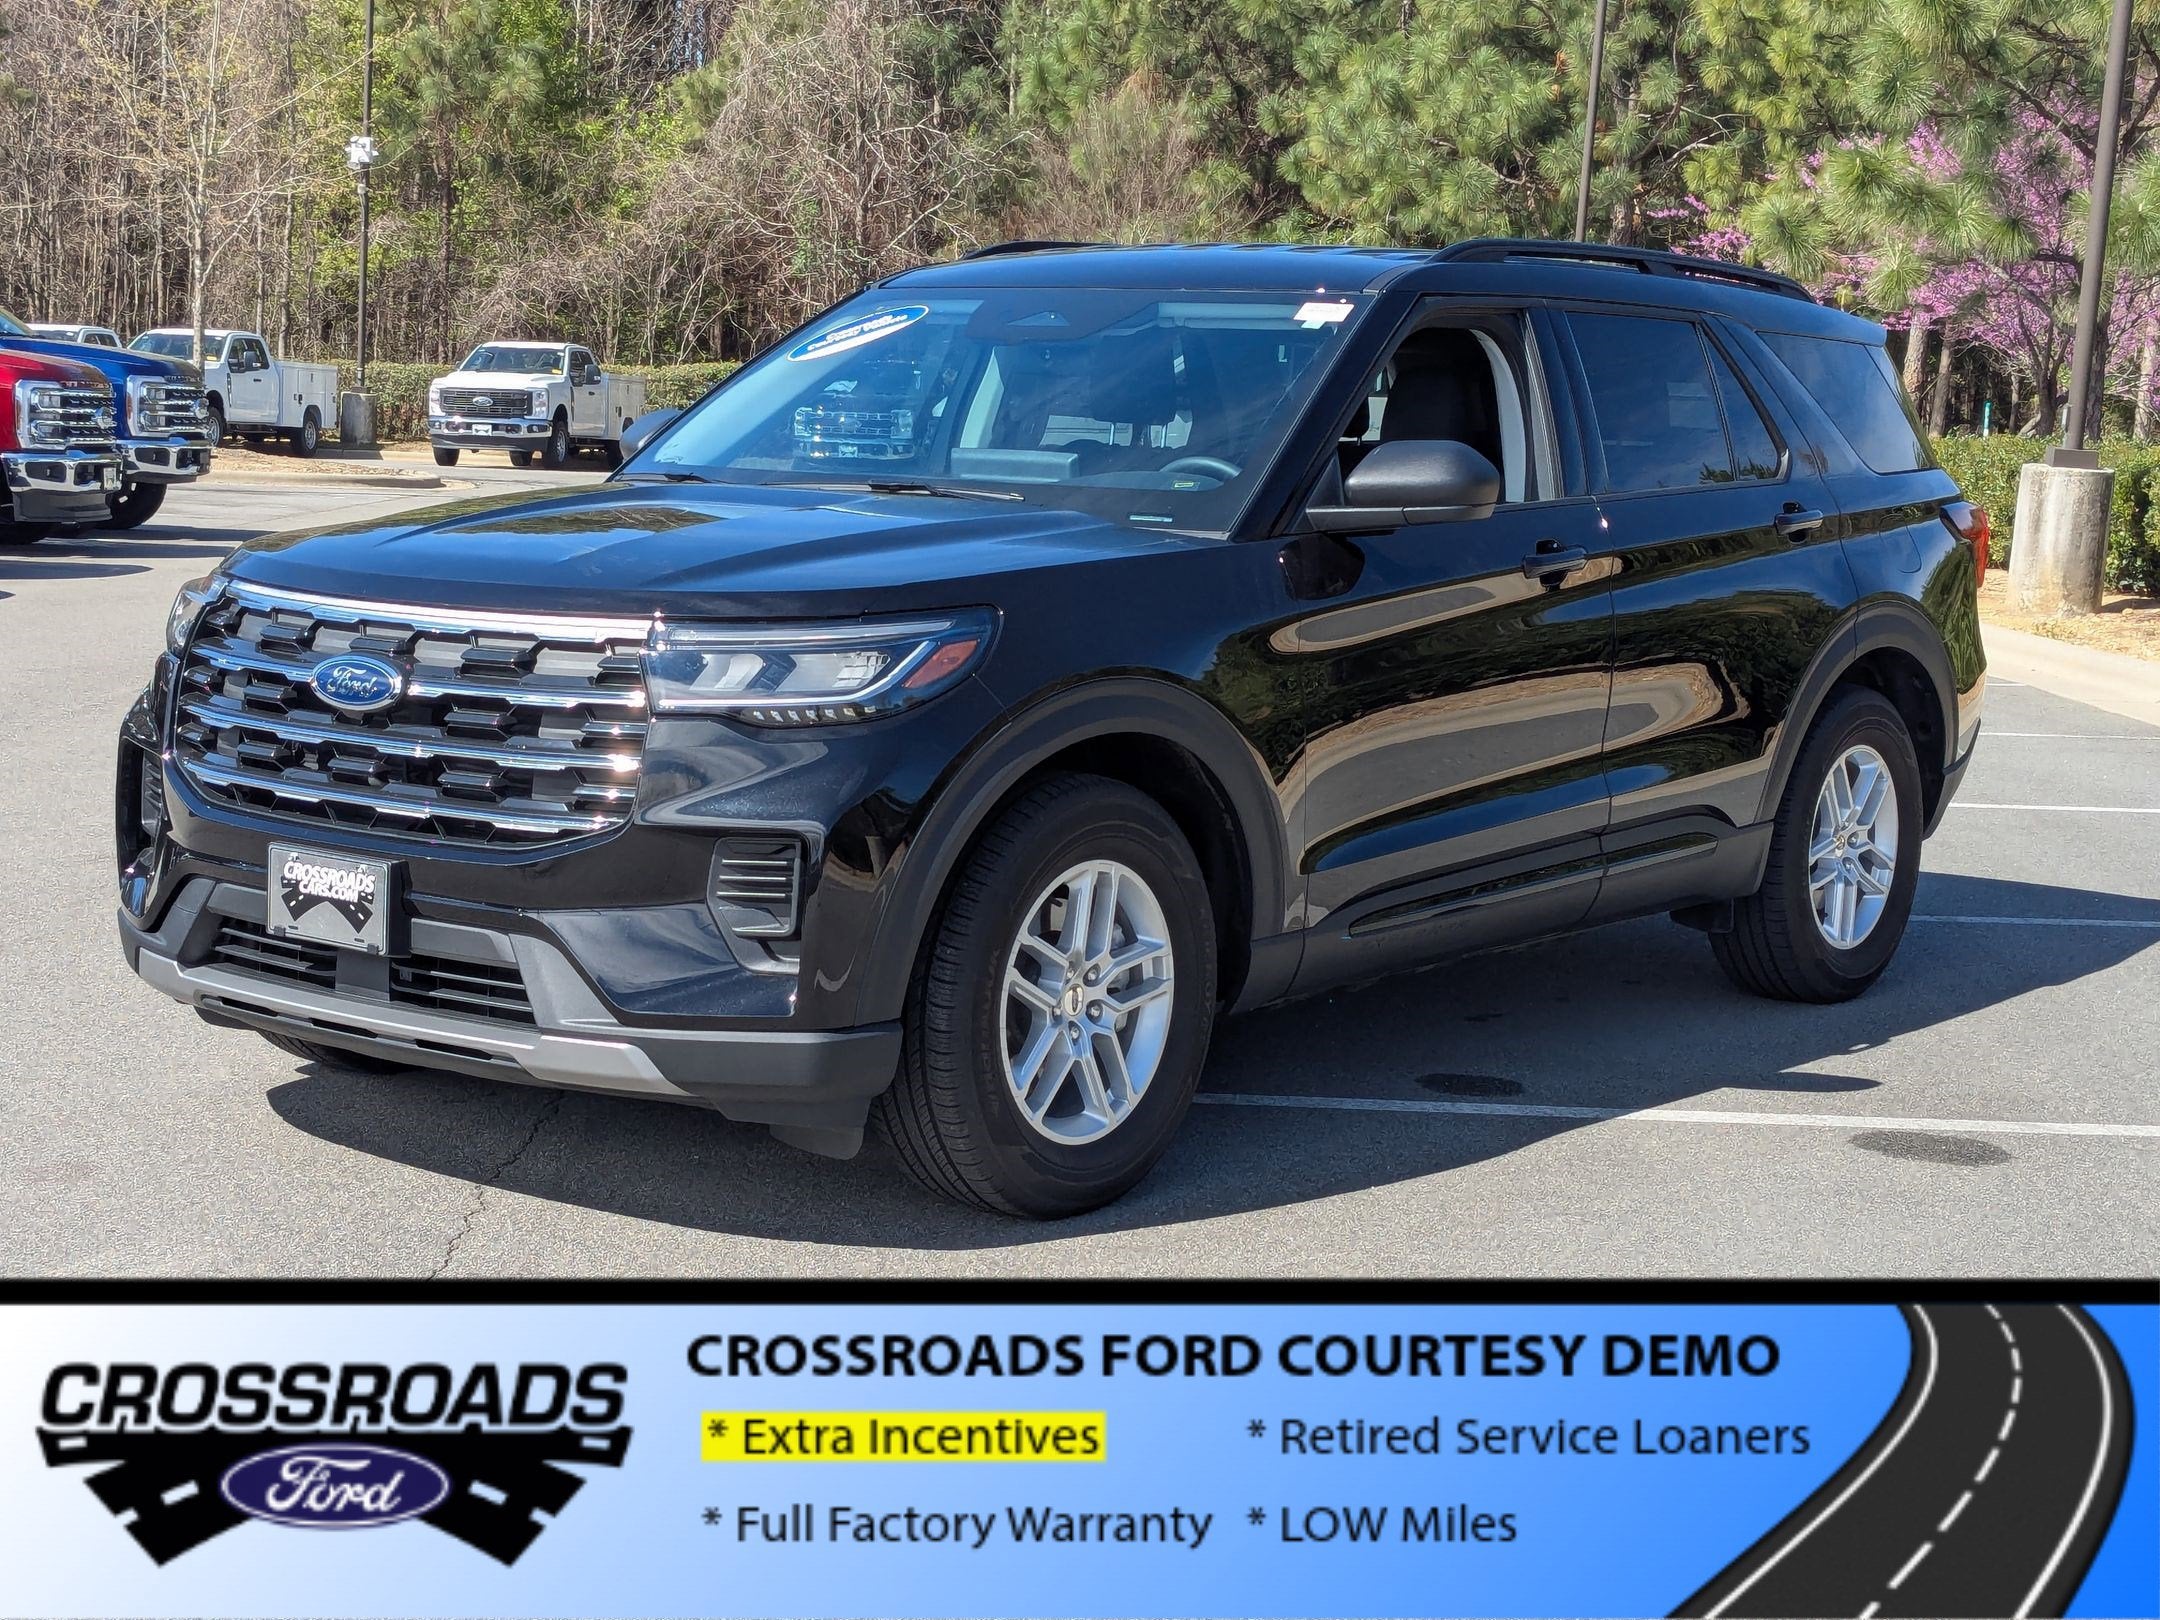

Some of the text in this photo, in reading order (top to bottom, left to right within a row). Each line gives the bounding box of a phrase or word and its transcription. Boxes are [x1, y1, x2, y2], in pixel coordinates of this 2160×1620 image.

[327, 665, 378, 698] Ford
[283, 861, 376, 893] CROSSROADS
[299, 880, 360, 903] CARS.COM
